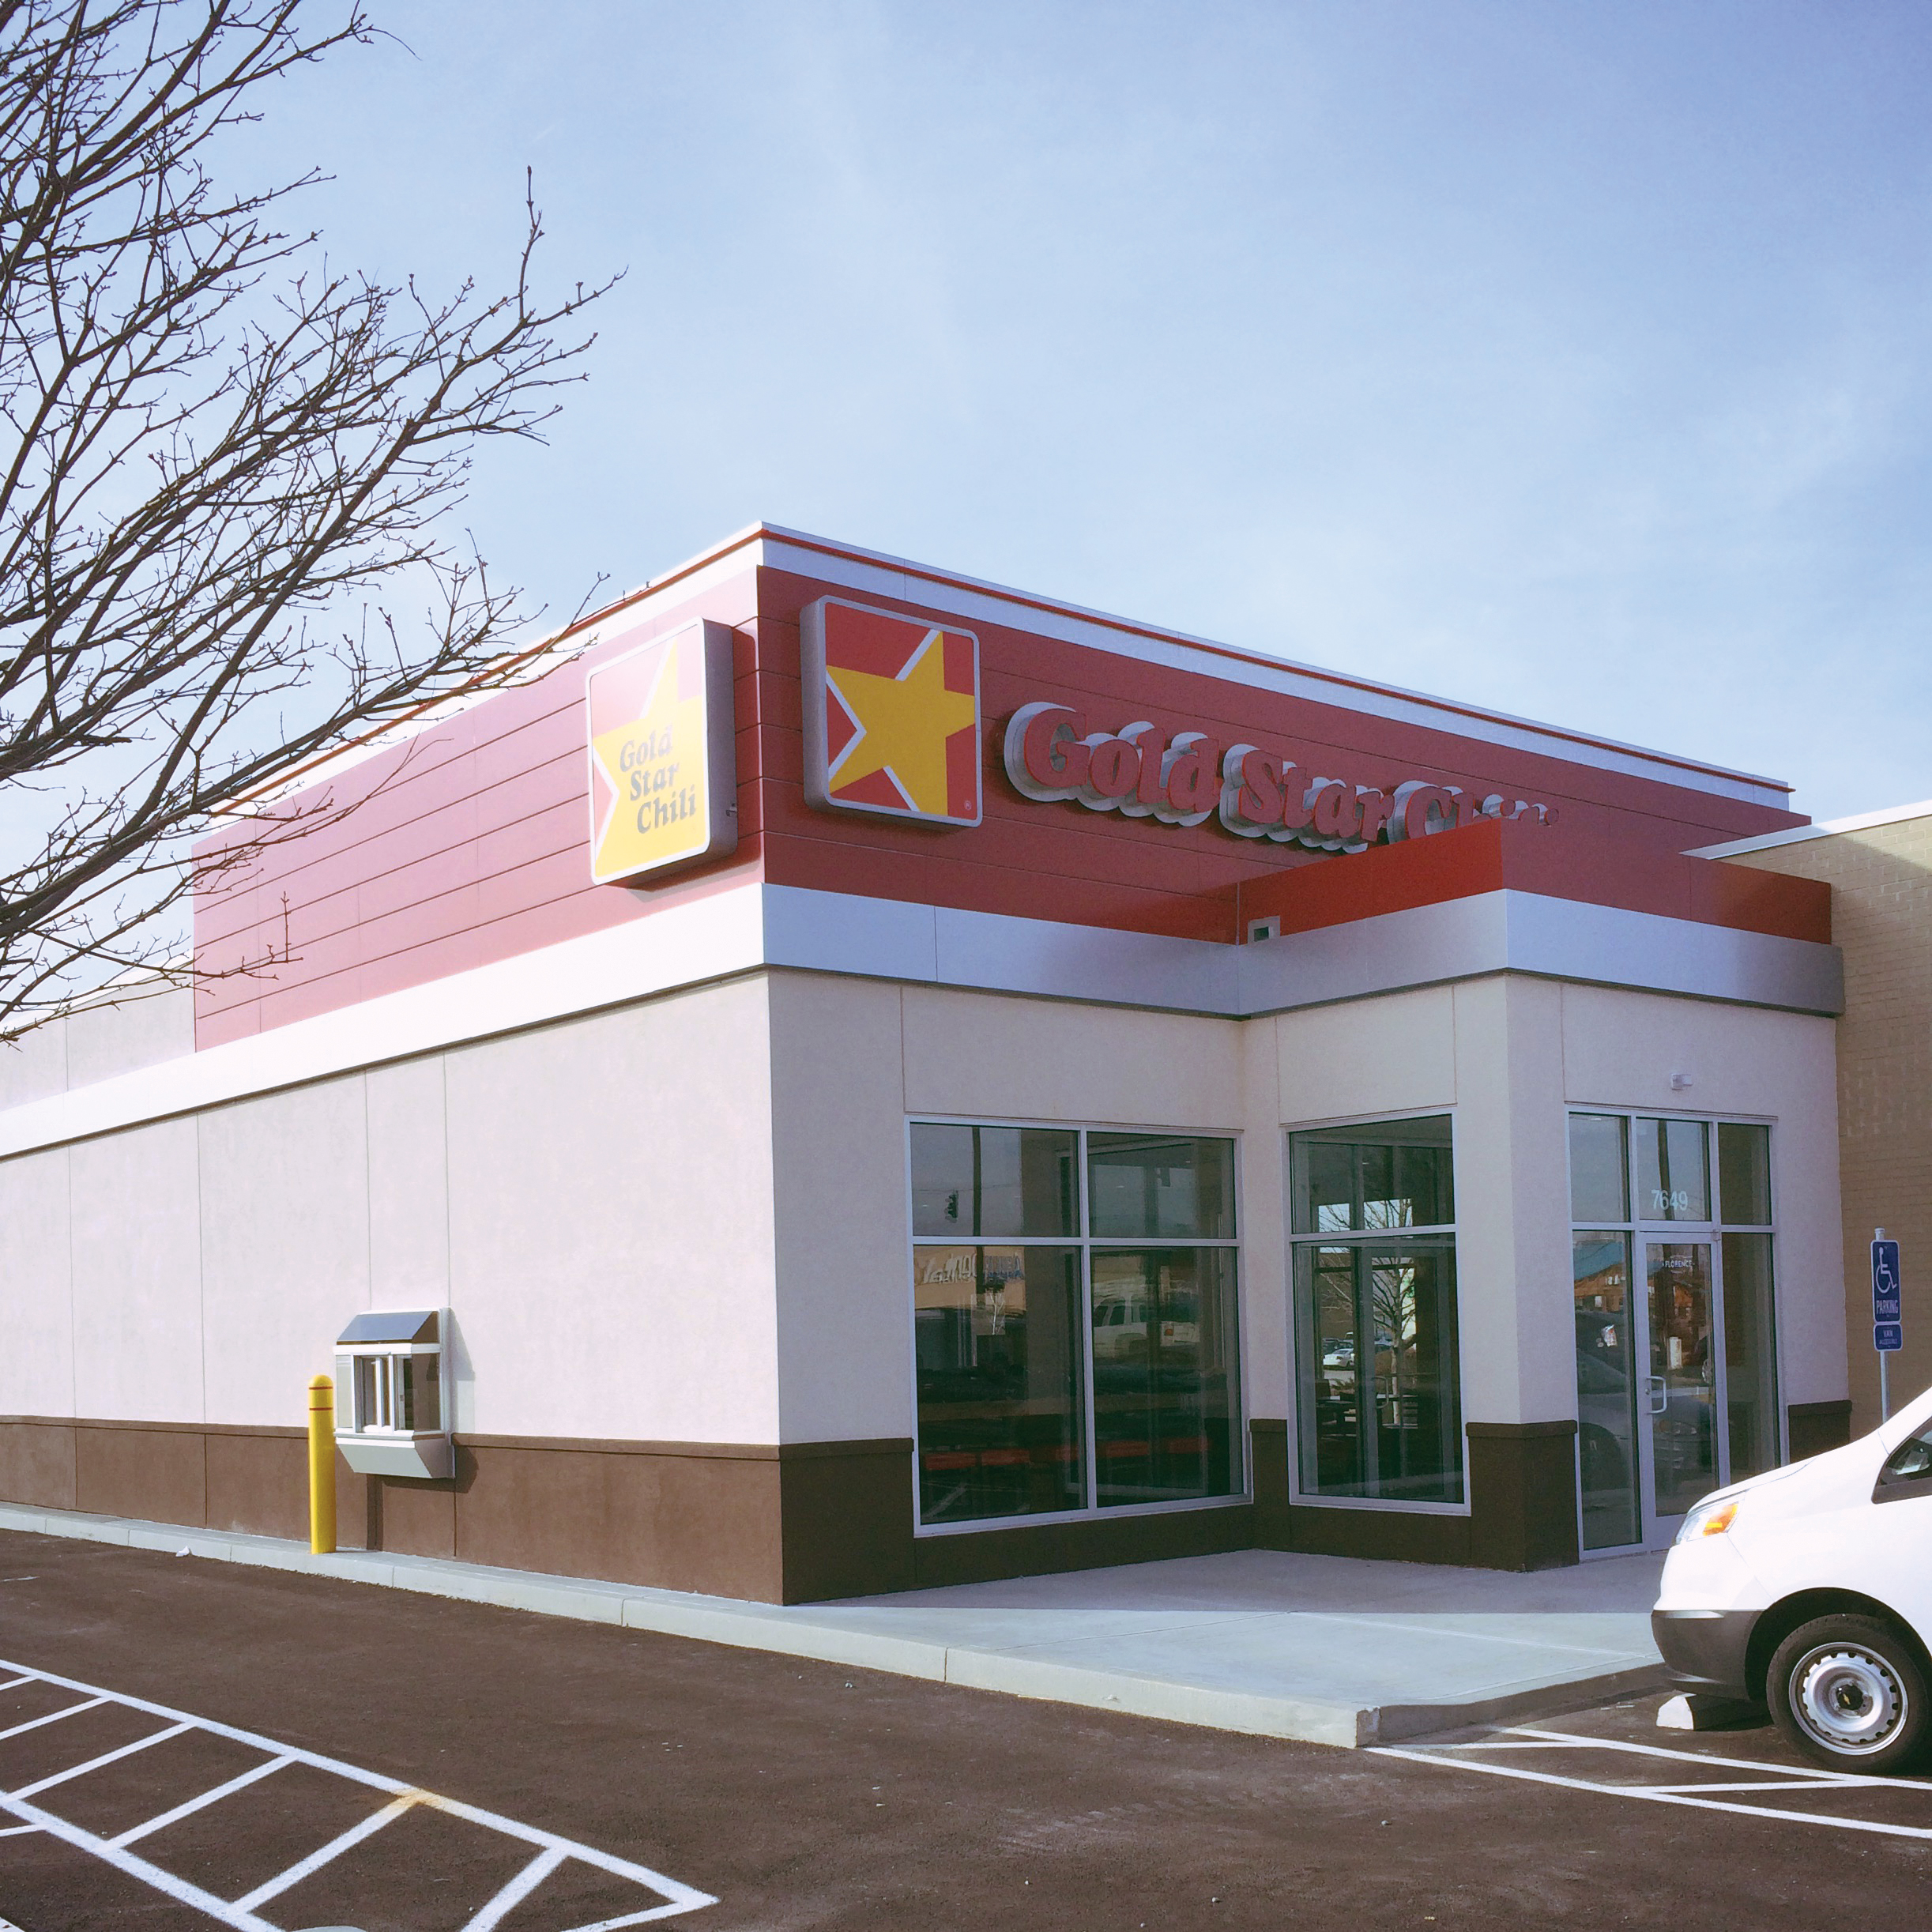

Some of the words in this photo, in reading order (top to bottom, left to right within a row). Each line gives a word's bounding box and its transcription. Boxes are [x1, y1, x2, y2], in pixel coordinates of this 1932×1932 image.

[620, 725, 672, 772] Gold
[630, 763, 680, 801] Star
[1004, 701, 1221, 827] Gold
[1222, 744, 1395, 853] Star
[637, 785, 696, 834] Chili
[1651, 1189, 1688, 1211] 7649
[1665, 1260, 1693, 1268] FLORENCE
[1876, 1300, 1899, 1314] PARKING
